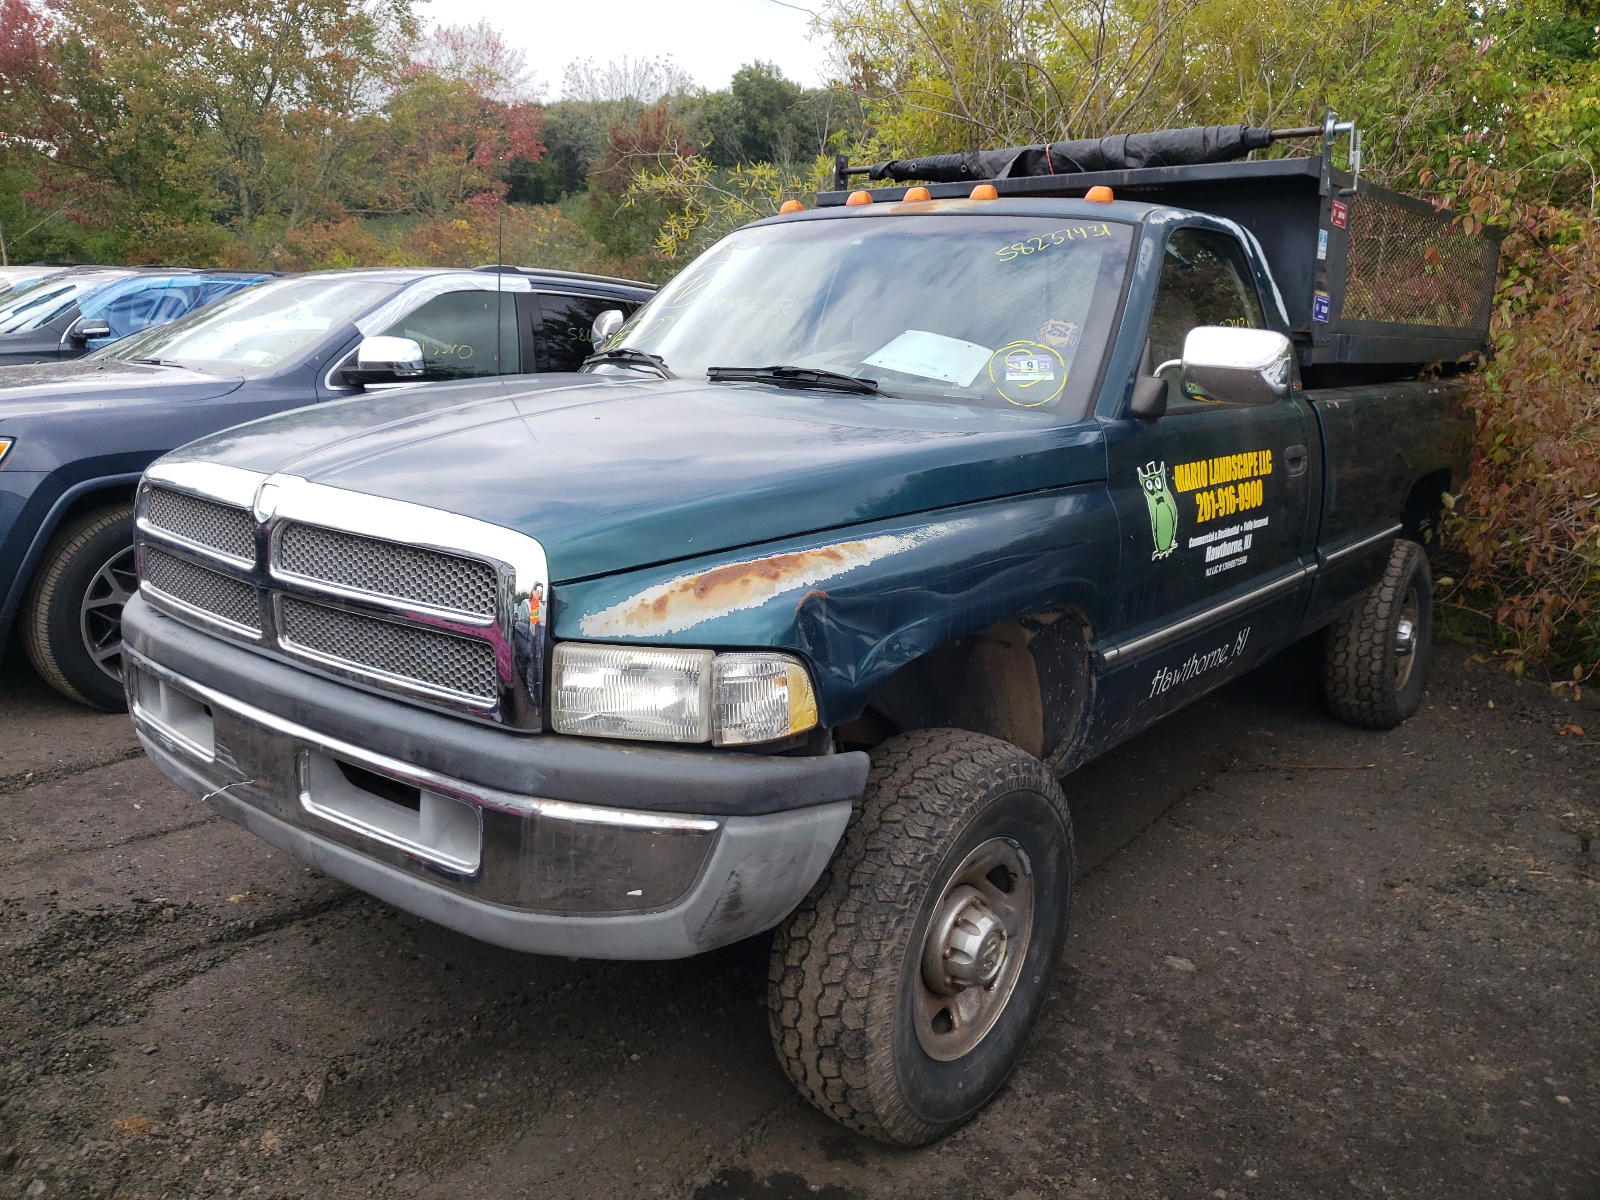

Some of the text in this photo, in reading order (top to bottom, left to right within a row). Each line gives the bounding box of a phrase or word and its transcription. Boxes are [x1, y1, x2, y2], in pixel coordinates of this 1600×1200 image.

[1174, 449, 1273, 493] MARIO LANDSCAPE LLC
[1195, 479, 1263, 523] 201-916-8900
[1205, 533, 1253, 563] Hawthorne, NJ
[1148, 626, 1251, 699] Hawthorne, NJ
